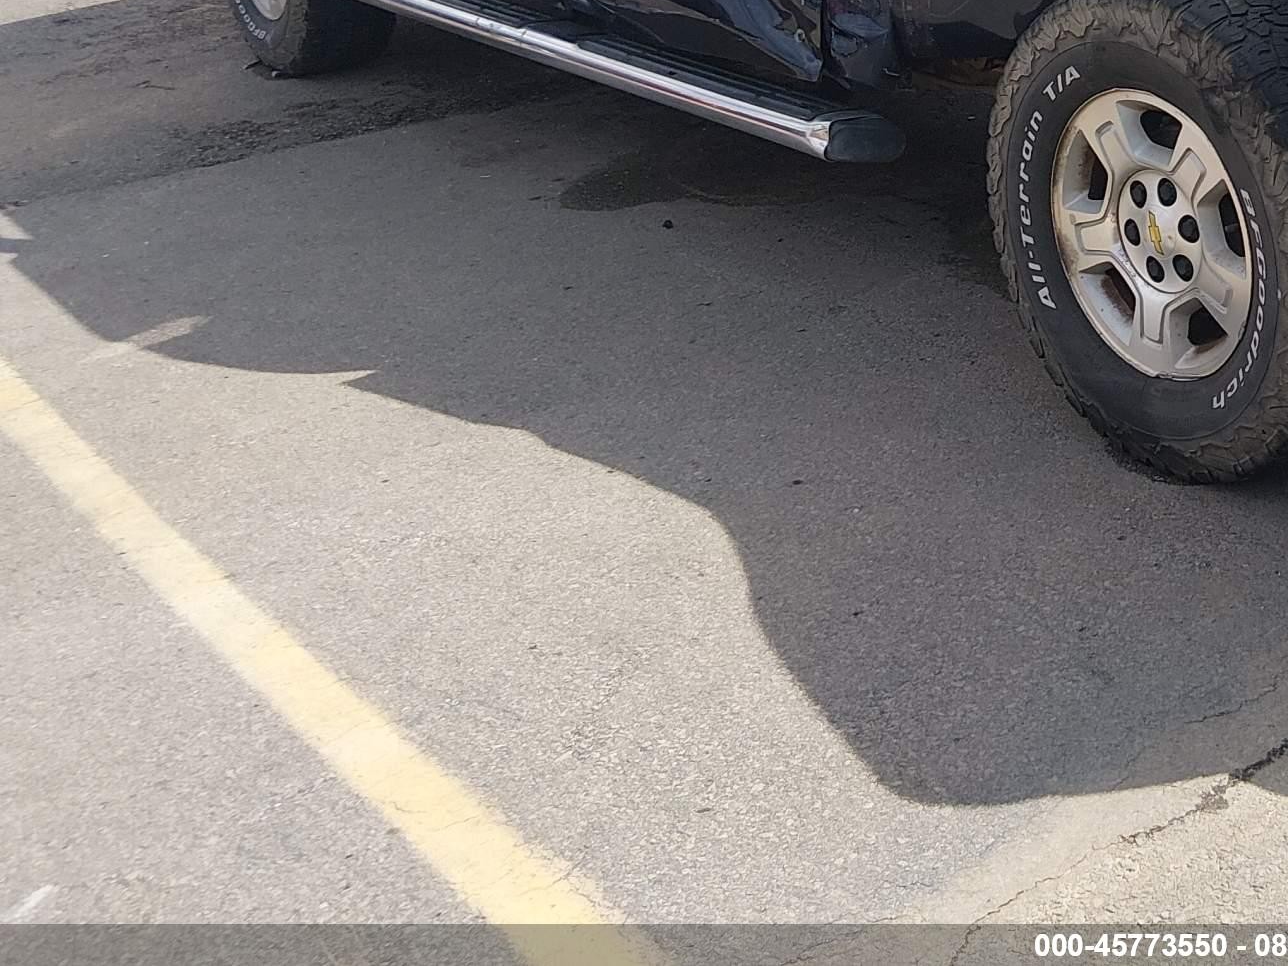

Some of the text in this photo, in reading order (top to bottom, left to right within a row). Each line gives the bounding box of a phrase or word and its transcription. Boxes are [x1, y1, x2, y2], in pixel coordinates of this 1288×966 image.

[1018, 65, 1081, 310] All-Terrain T/A
[1212, 188, 1267, 409] BFGoodrich
